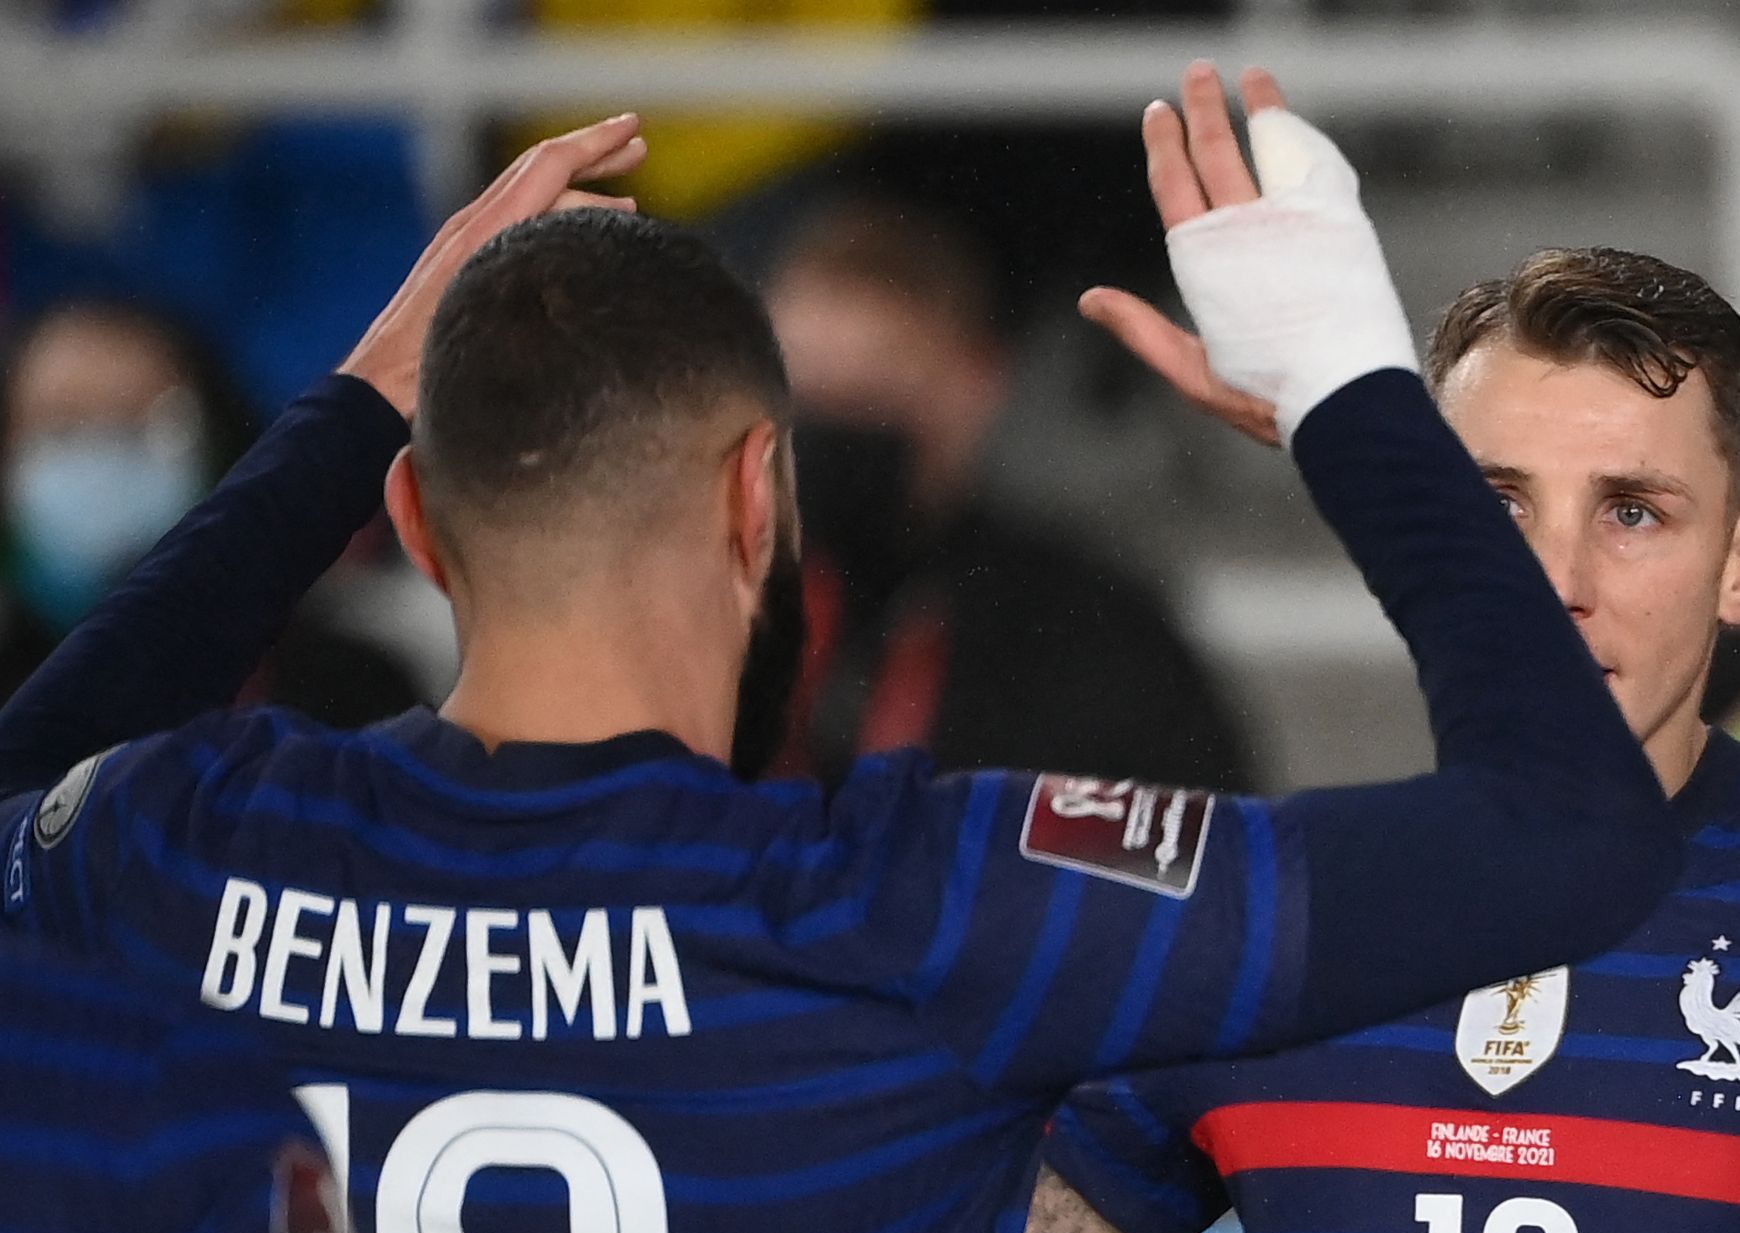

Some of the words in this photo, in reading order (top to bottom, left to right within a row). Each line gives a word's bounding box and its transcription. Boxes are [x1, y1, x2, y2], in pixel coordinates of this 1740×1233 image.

[200, 876, 693, 1042] BENZEMA
[1431, 1122, 1490, 1143] FINLANDE
[1502, 1126, 1552, 1147] FRANCE
[1426, 1139, 1442, 1159] 16
[1445, 1141, 1514, 1164] NOVEMBRE
[1517, 1147, 1555, 1166] 2021
